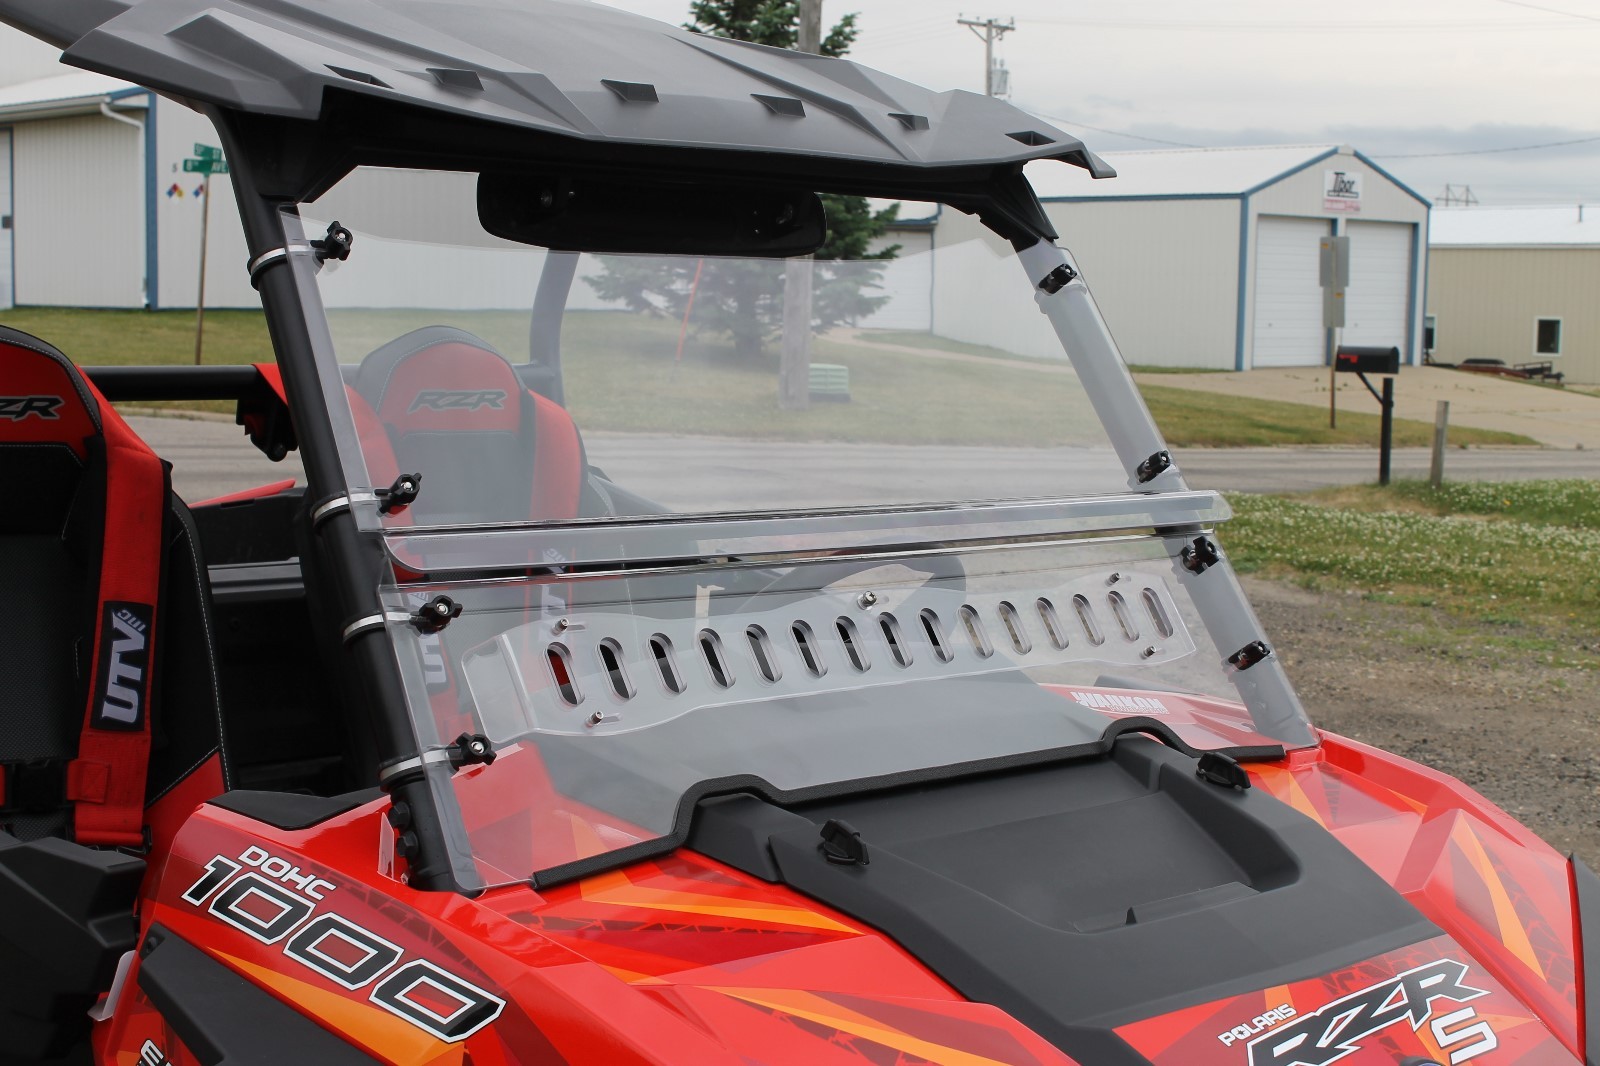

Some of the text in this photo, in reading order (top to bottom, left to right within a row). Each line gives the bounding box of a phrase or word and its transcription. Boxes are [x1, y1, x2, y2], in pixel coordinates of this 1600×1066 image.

[211, 161, 228, 172] AVE
[407, 389, 508, 415] RZR
[101, 611, 145, 723] UTV
[238, 845, 337, 900] DOHC
[181, 854, 507, 1043] 1000
[1217, 1003, 1298, 1048] POLARIS
[1246, 958, 1493, 1066] RZR
